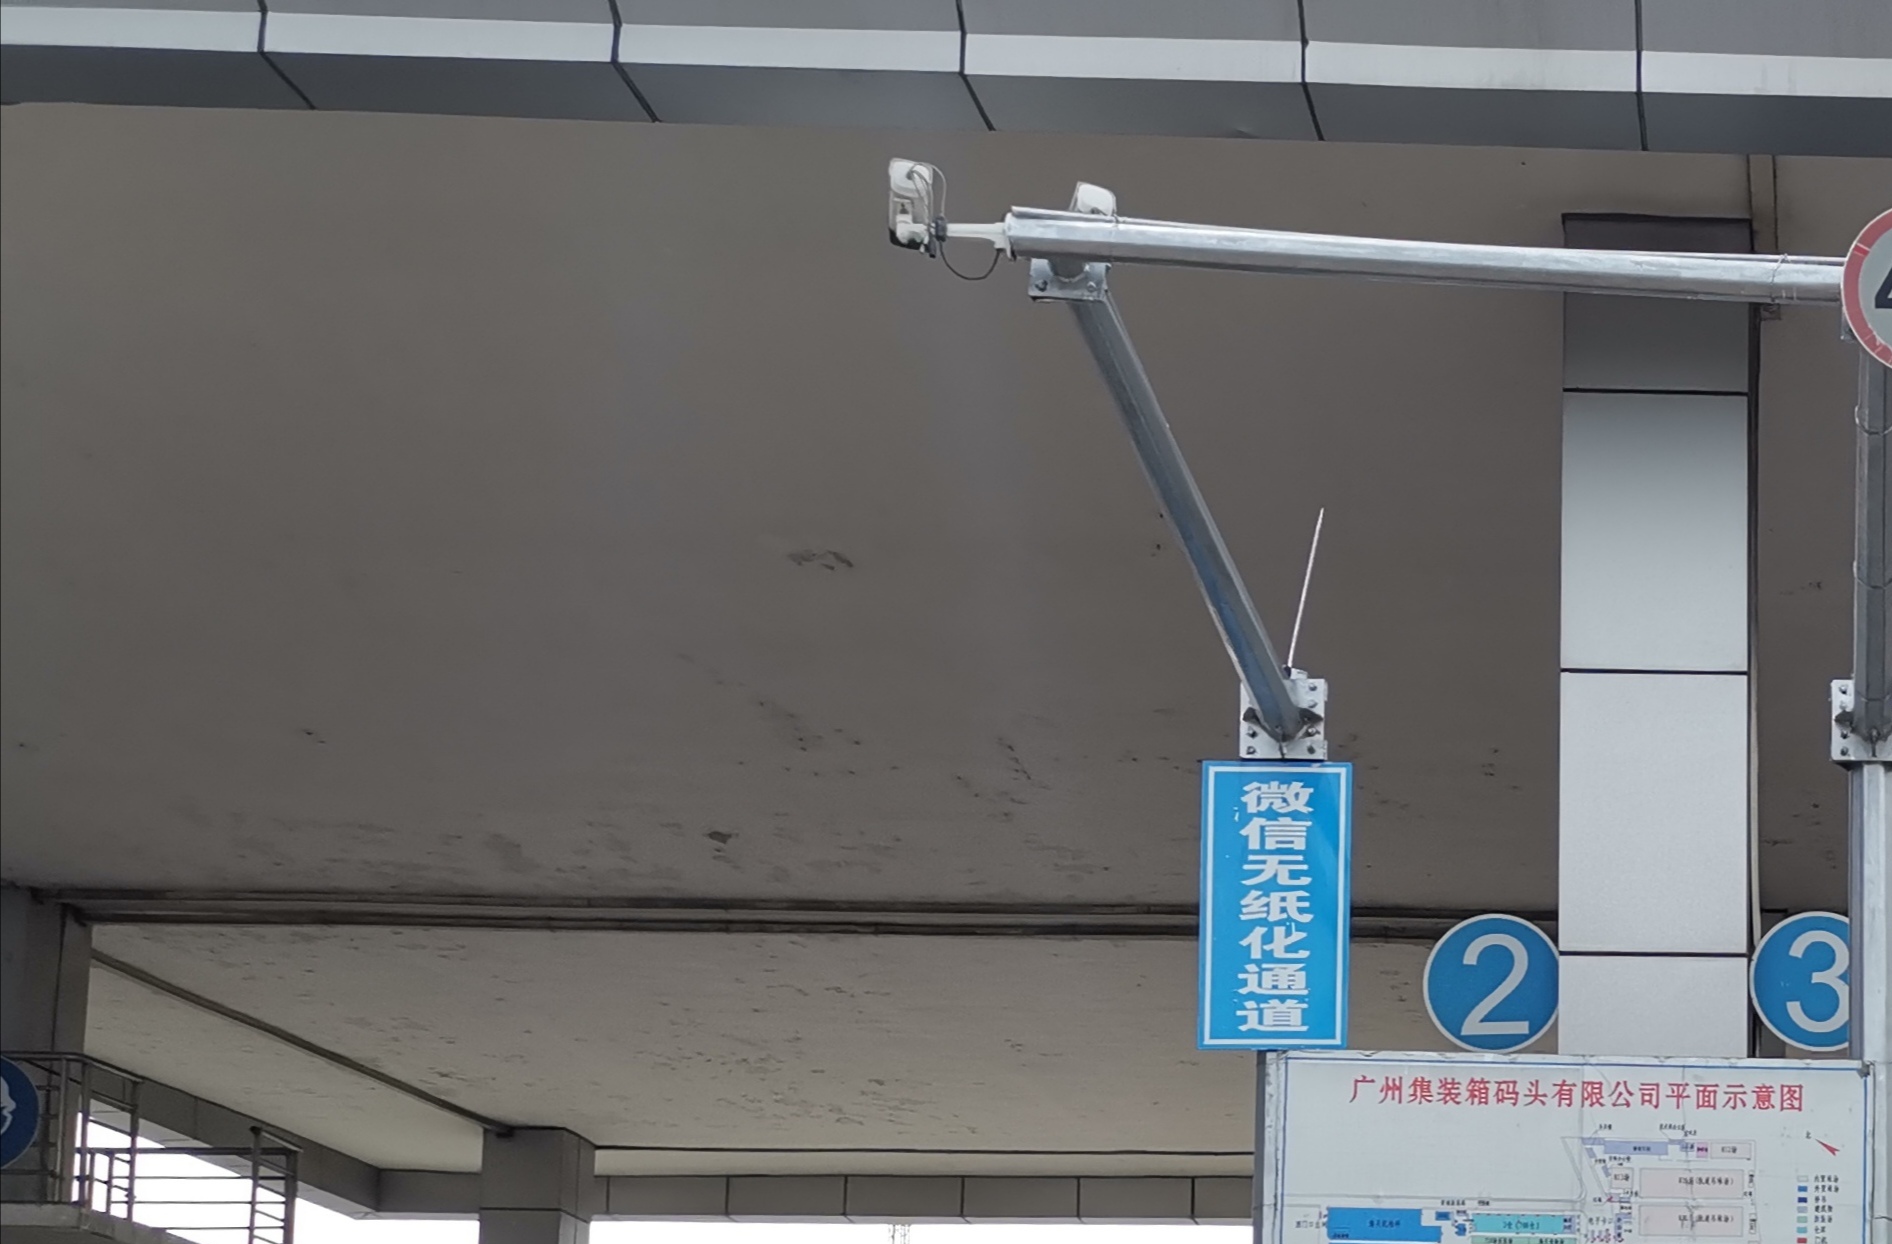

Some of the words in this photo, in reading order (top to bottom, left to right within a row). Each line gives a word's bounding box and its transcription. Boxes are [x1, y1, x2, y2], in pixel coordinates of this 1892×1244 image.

[1235, 780, 1314, 1032] 微信无纸化通道
[1460, 932, 1530, 1036] 2
[1785, 929, 1850, 1033] 3
[1349, 1074, 1805, 1114] 广州集装箱码头有限公司平面示意图
